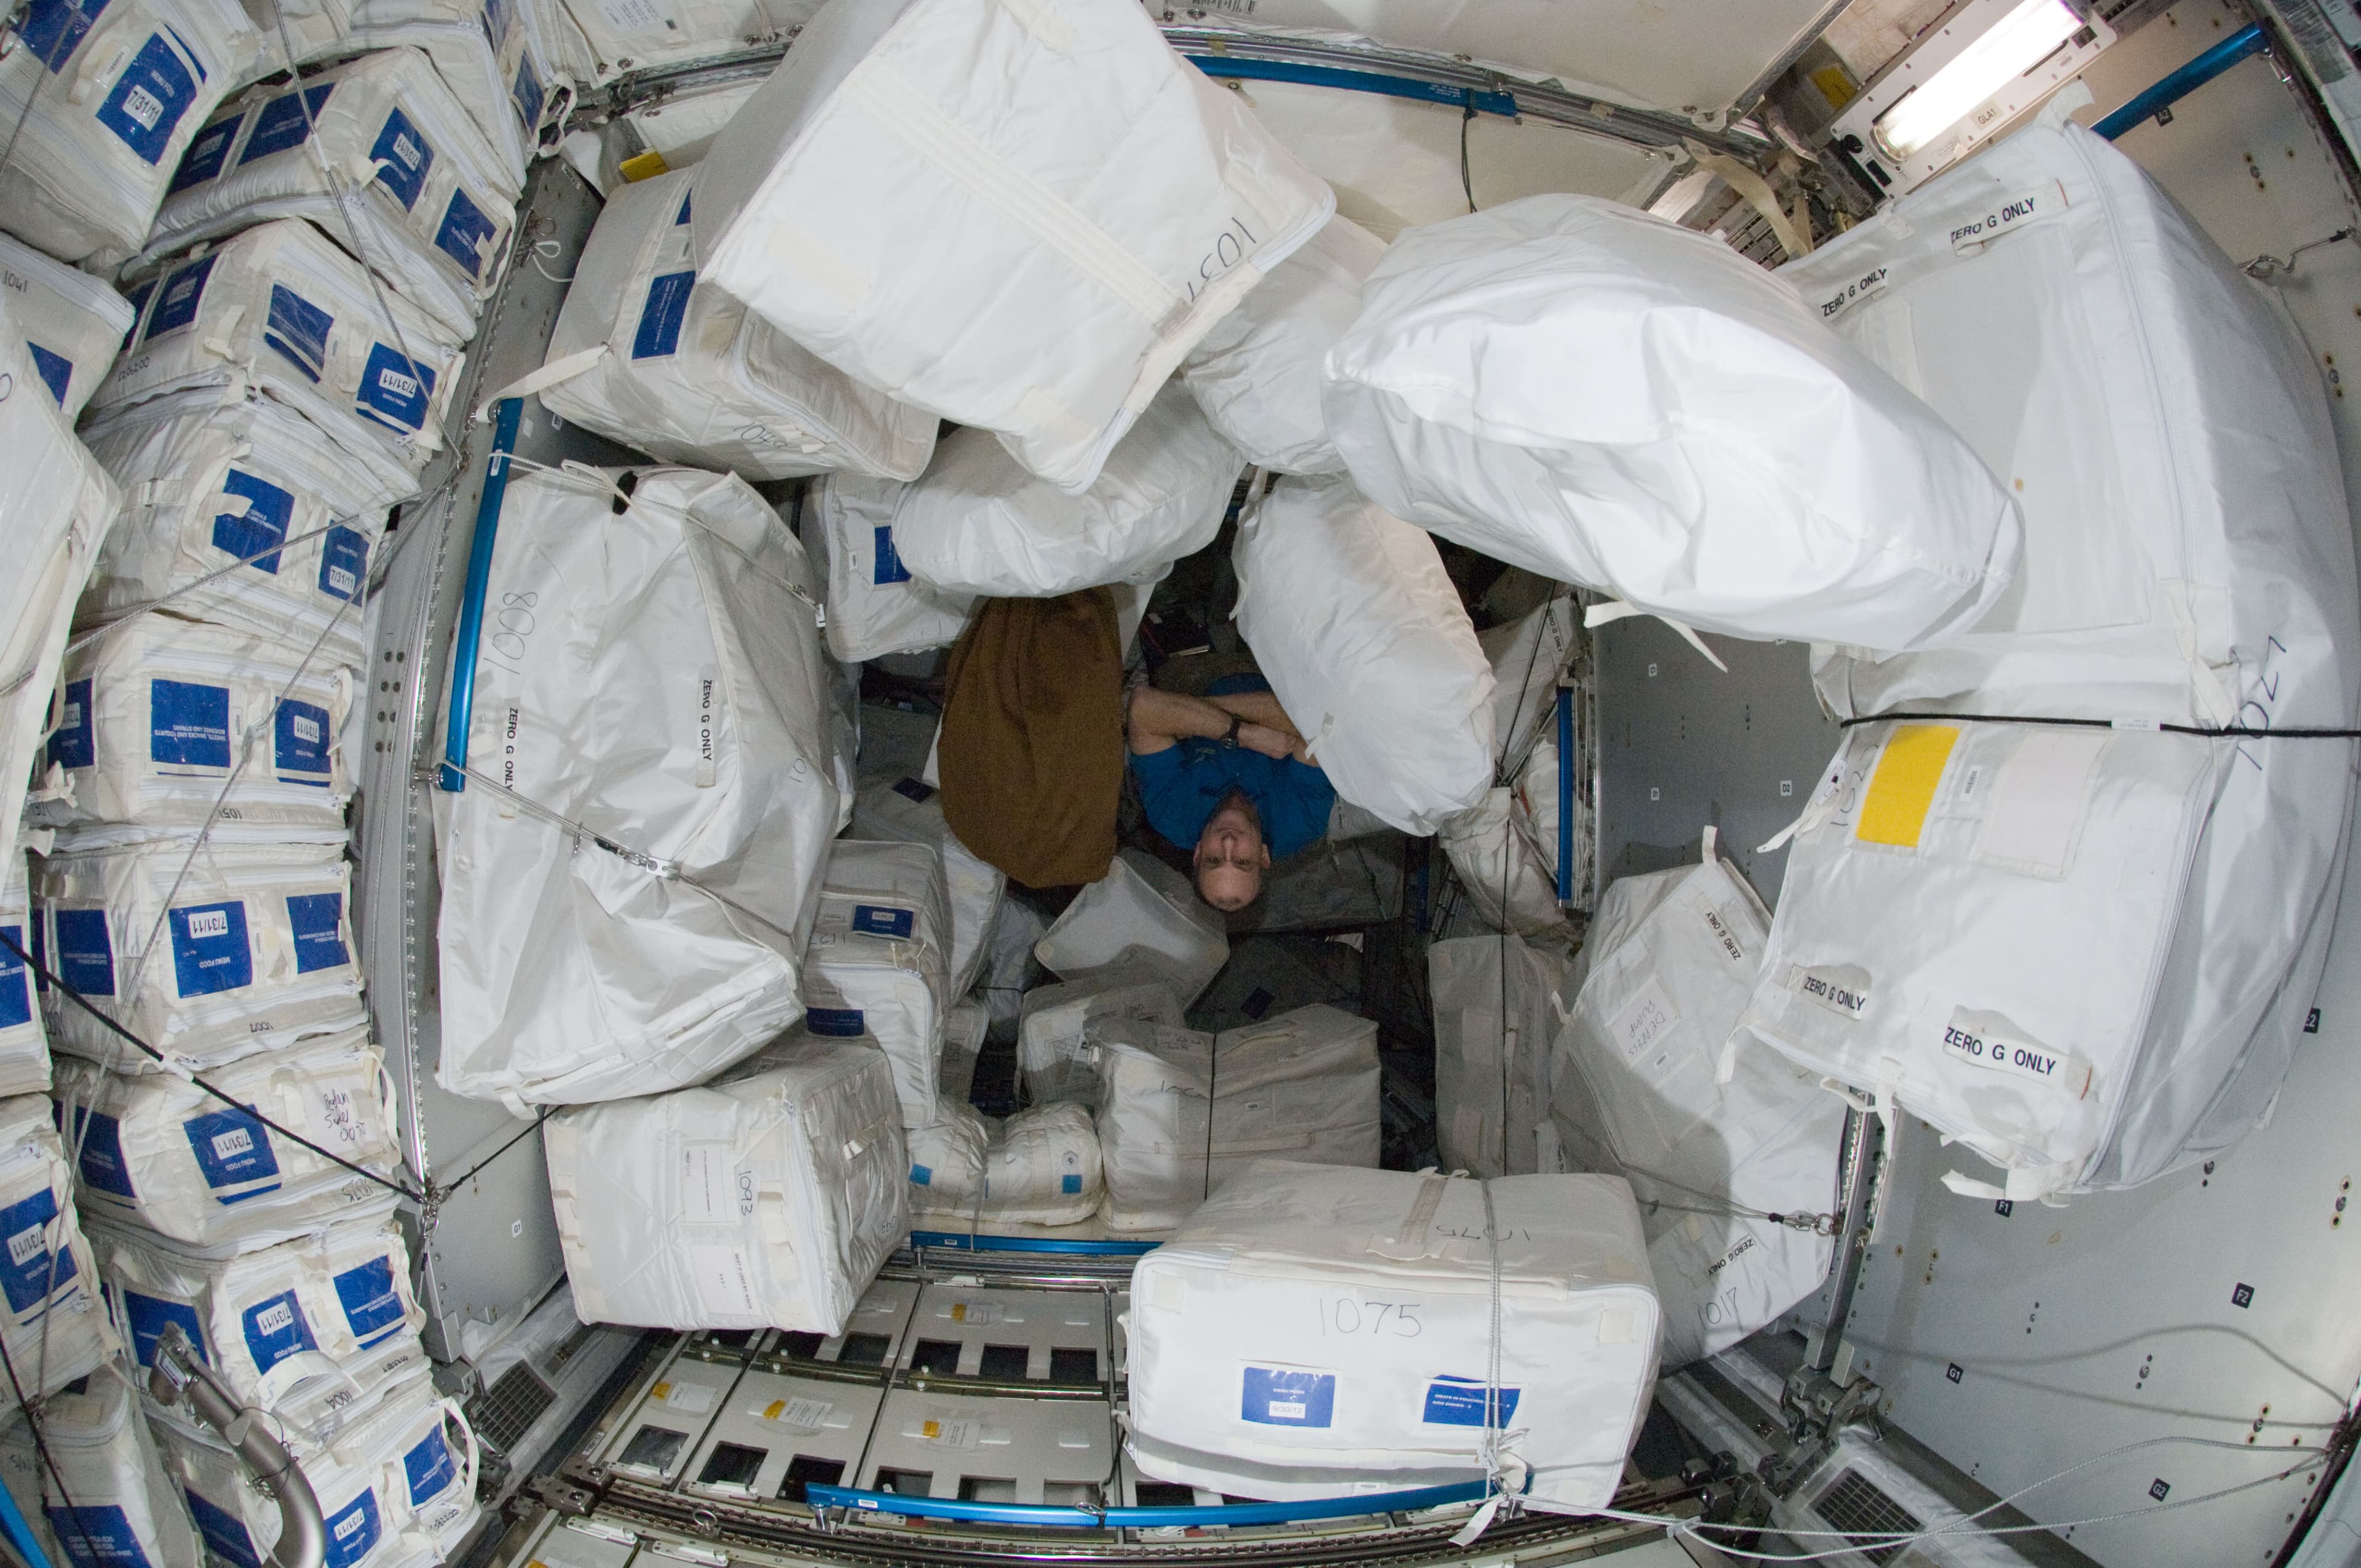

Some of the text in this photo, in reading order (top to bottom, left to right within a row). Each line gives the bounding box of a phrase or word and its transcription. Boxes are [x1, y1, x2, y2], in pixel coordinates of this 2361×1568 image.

[127, 90, 159, 124] 7/31/11
[1977, 108, 1996, 125] GLA1
[2158, 109, 2170, 122] A2
[397, 138, 421, 167] 7/31/11
[1950, 197, 2035, 244] ZERO G ONLY
[3, 269, 28, 293] 1041
[1821, 267, 1887, 318] ZERO G ONLY
[382, 373, 416, 394] 7/31/11
[331, 569, 354, 591] 7/31/11
[483, 592, 538, 675] 1008
[1554, 636, 1564, 653] ONLY
[701, 679, 713, 761] ZERO G ONLY
[296, 721, 319, 740] 7/31/11
[504, 707, 519, 791] ZERO G ONLY
[192, 916, 226, 933] 7/31/11
[1705, 911, 1721, 930] ONLY
[1723, 938, 1741, 960] ZERO
[199, 956, 231, 969] MENU FOOD
[1803, 976, 1866, 1012] ZERO G ONLY
[250, 1021, 274, 1033] 1007
[1944, 1026, 2057, 1076] ZERO G ONLY
[217, 1133, 252, 1153] 7/31/11
[226, 1157, 256, 1171] MENU FOOD
[739, 1171, 753, 1216] 1093
[1999, 1202, 2009, 1213] F1
[514, 1224, 521, 1233] G1
[13, 1229, 45, 1259] 7/31/11
[1734, 1238, 1754, 1256] ZERO
[1707, 1259, 1726, 1277] ONLY
[2236, 1290, 2249, 1303] F2
[262, 1308, 291, 1329] 7/31/11
[1319, 1297, 1422, 1337] 1075
[1697, 1286, 1742, 1332] 1017
[274, 1342, 303, 1359] MENU FOOD
[1949, 1368, 1960, 1380] G1
[1272, 1404, 1303, 1414] 9/30/12
[2153, 1483, 2164, 1497] G2
[338, 1510, 364, 1537] 7/31/11
